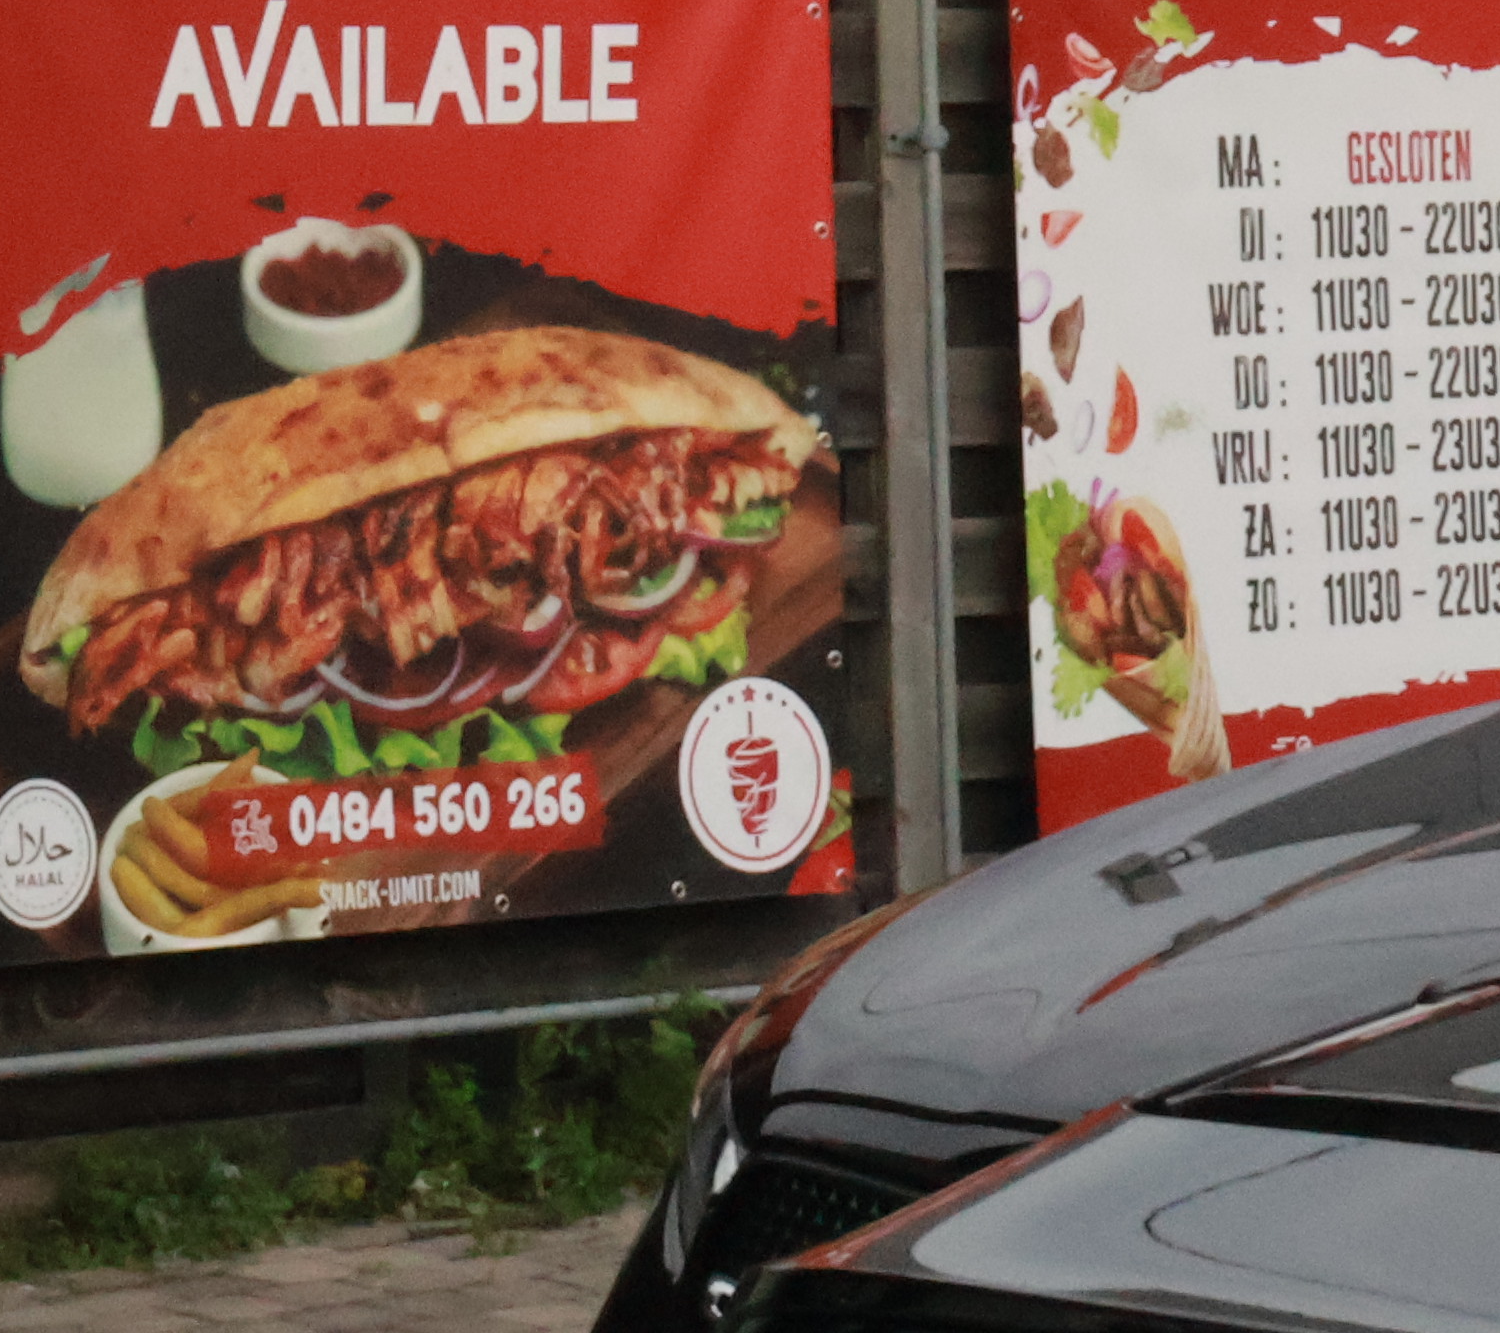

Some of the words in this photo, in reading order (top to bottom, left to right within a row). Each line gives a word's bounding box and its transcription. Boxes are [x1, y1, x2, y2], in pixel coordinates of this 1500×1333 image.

[1347, 130, 1471, 184] GESLOTEN
[1311, 204, 1388, 258] 11U30
[1312, 277, 1390, 332] 11U30
[1315, 350, 1392, 405] 11U30
[1318, 423, 1394, 478] 11U30
[1321, 496, 1398, 552] 11U30
[1324, 569, 1401, 625] 11U30
[289, 788, 396, 846] 0484
[412, 781, 491, 836] 560
[507, 773, 586, 829] 266
[319, 870, 481, 911] SNACK-UMIT.COM
